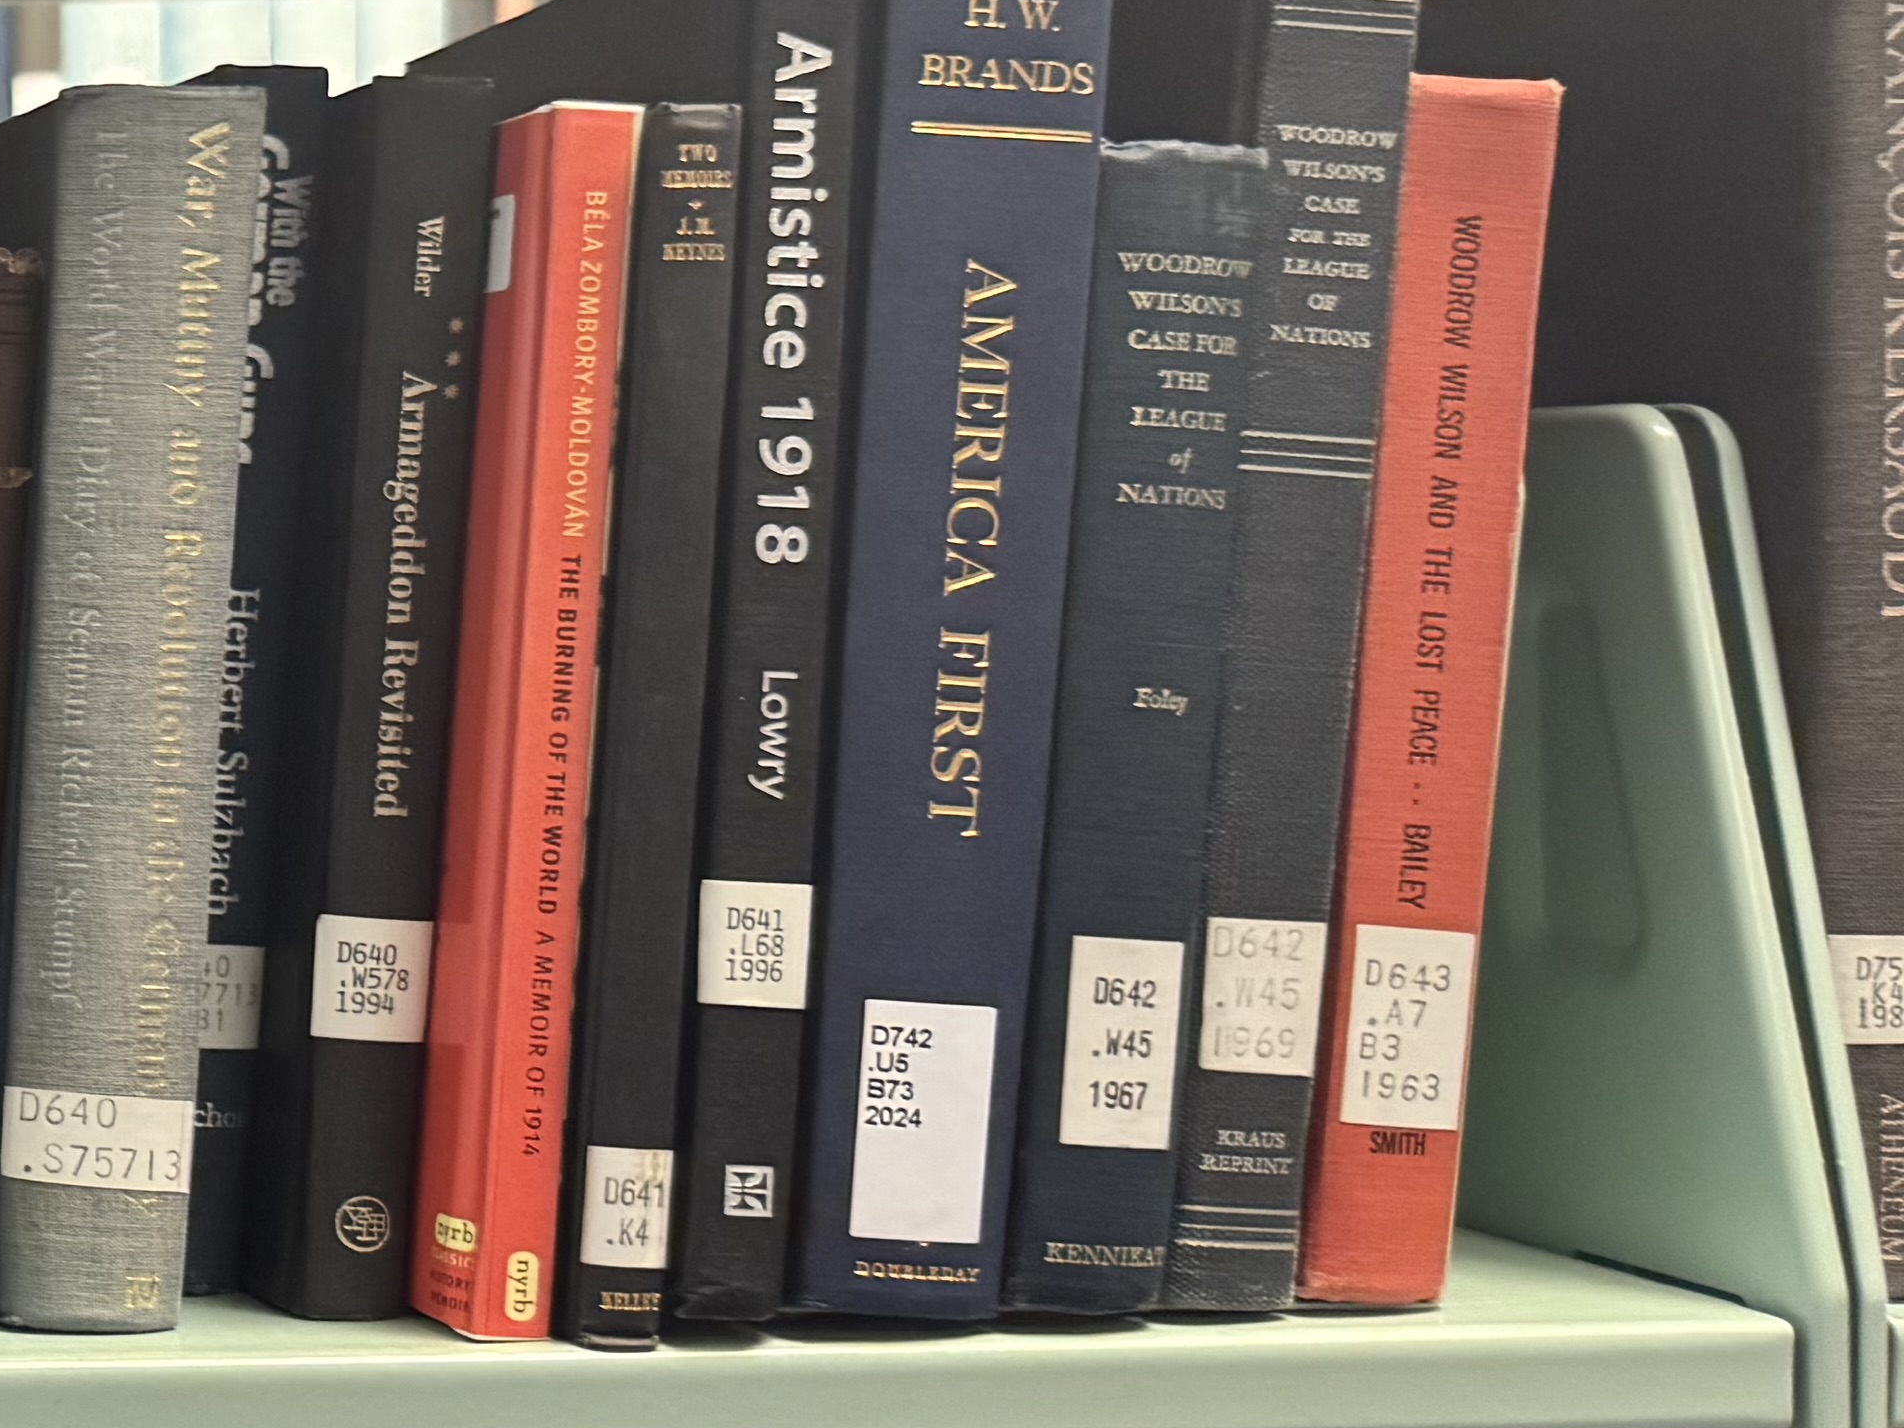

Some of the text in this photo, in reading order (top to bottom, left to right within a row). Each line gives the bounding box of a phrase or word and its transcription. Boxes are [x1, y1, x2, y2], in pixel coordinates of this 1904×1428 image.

[917, 55, 1094, 94] BRANDS
[413, 215, 444, 298] Wilder
[583, 190, 608, 253] BÉLA
[754, 32, 834, 564] Armistice 1918
[1427, 215, 1482, 529] WOODROW WILSON AND
[927, 259, 1019, 837] AMERICA FIRST
[748, 670, 798, 801] Lowry
[1397, 824, 1431, 911] BAILEY
[510, 1257, 531, 1314] nyrb
